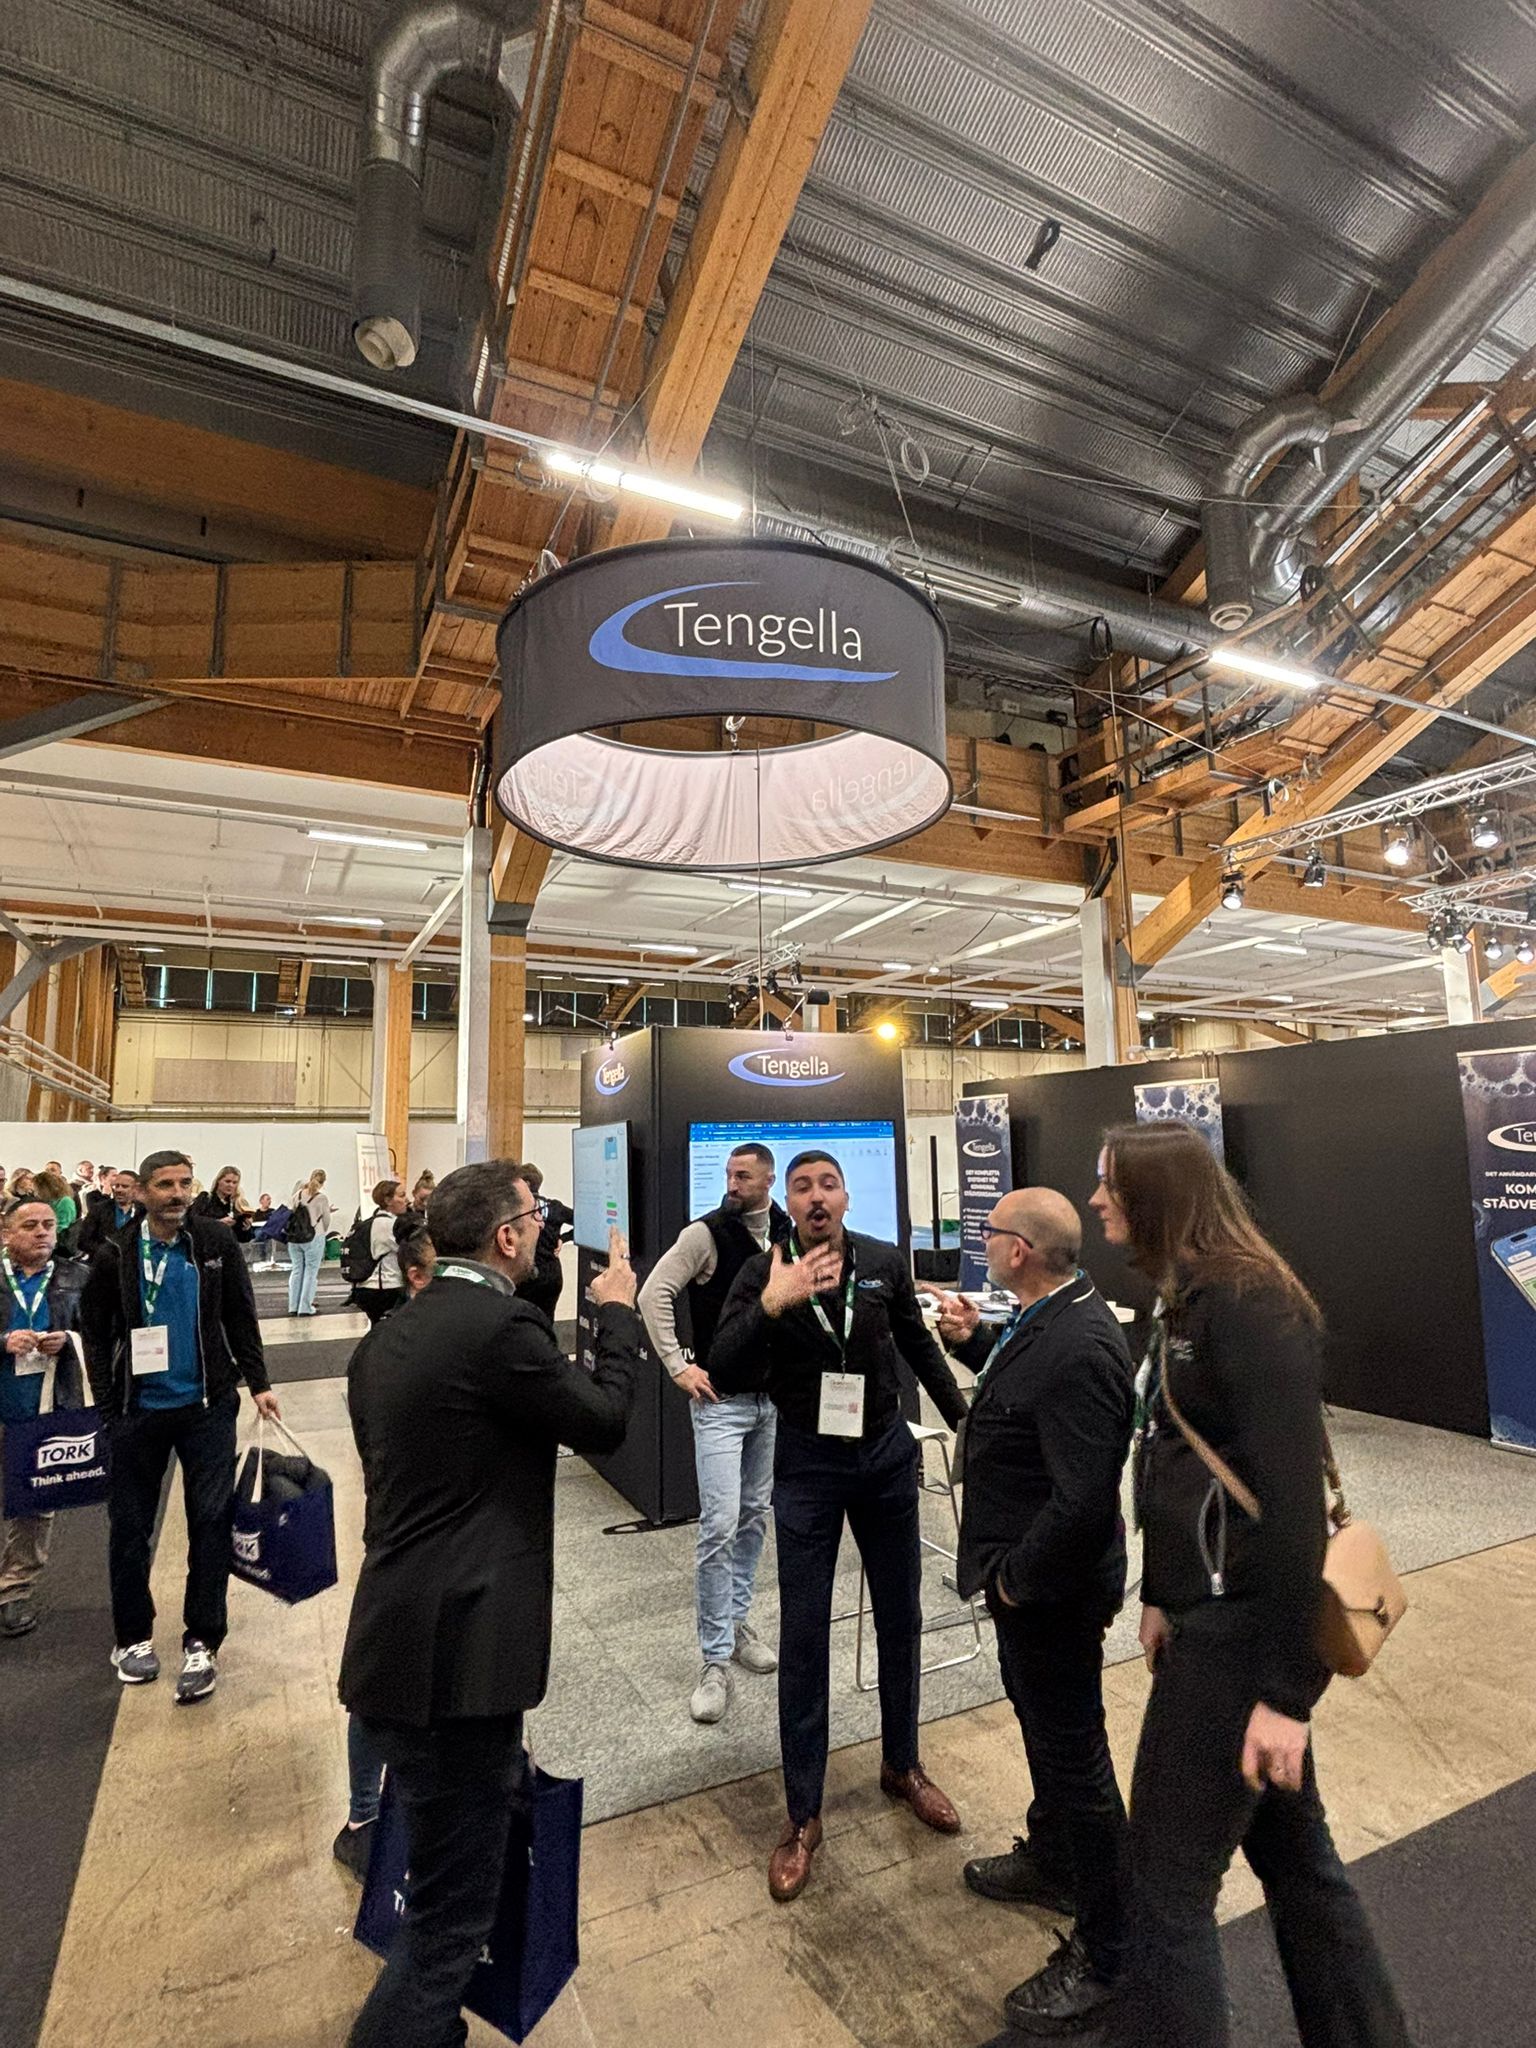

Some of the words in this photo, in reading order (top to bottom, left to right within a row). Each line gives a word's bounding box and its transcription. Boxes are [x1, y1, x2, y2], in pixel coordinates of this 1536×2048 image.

[663, 602, 862, 662] Tengella
[757, 1055, 829, 1079] Tengella
[41, 1443, 92, 1464] TORK
[31, 1474, 64, 1487] Think
[65, 1466, 106, 1482] ahead.
